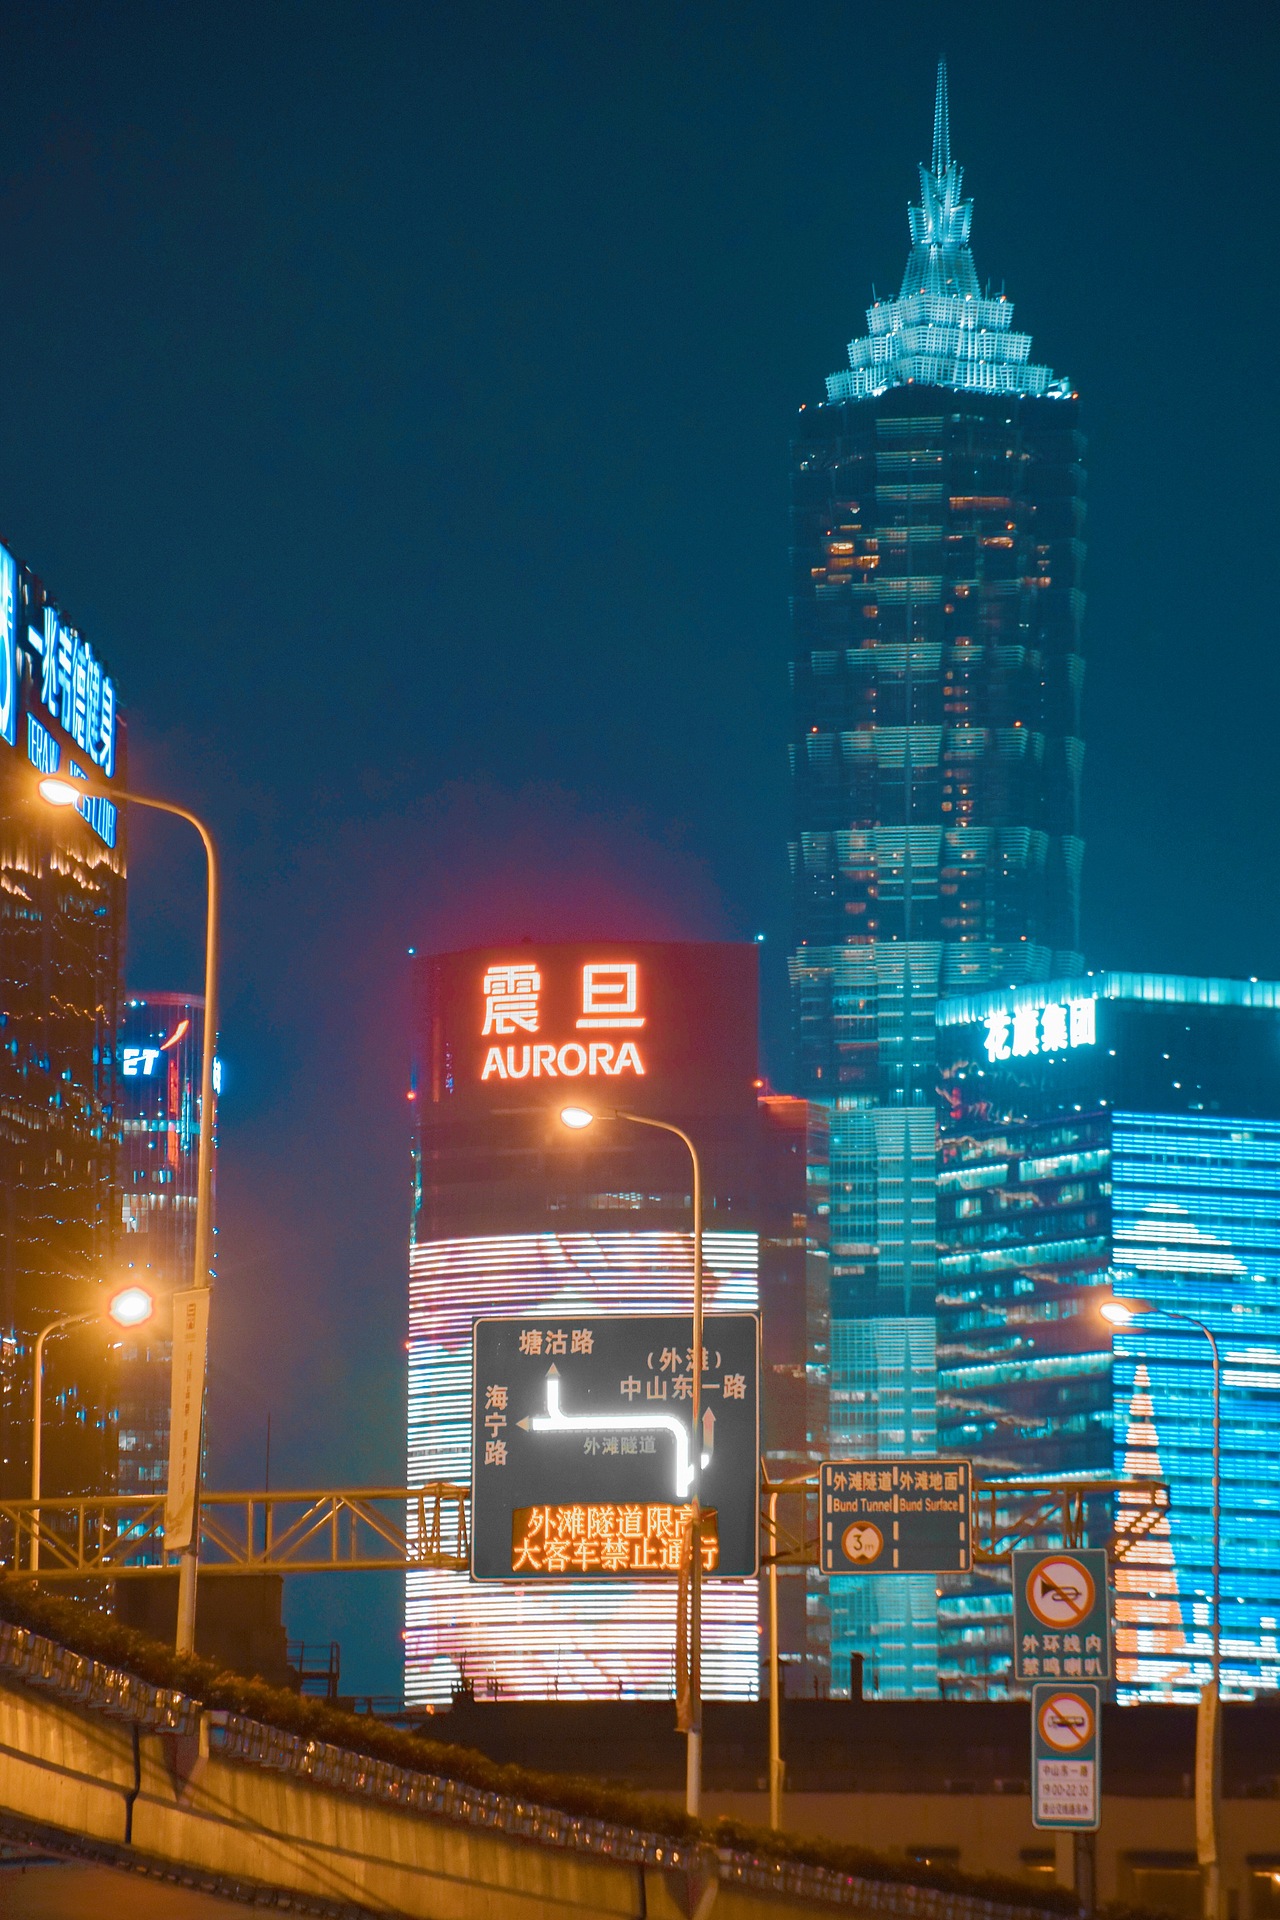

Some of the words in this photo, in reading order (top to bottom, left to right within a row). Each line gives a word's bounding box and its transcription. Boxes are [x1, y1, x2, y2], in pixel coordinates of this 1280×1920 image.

[27, 606, 116, 778] 一兆韦德健身
[481, 964, 645, 1035] 震旦
[481, 1042, 645, 1080] AURORA
[518, 1329, 595, 1355] 塘沽路
[620, 1373, 747, 1401] 中山东一路
[484, 1384, 509, 1466] 海宁路
[583, 1435, 657, 1456] 外滩隧道
[833, 1471, 893, 1492] 外滩隧道
[899, 1471, 959, 1492] 外滩地面
[833, 1498, 858, 1512] Bund
[860, 1498, 893, 1512] Tunnel
[900, 1498, 923, 1512] Bund
[925, 1498, 959, 1512] Surface
